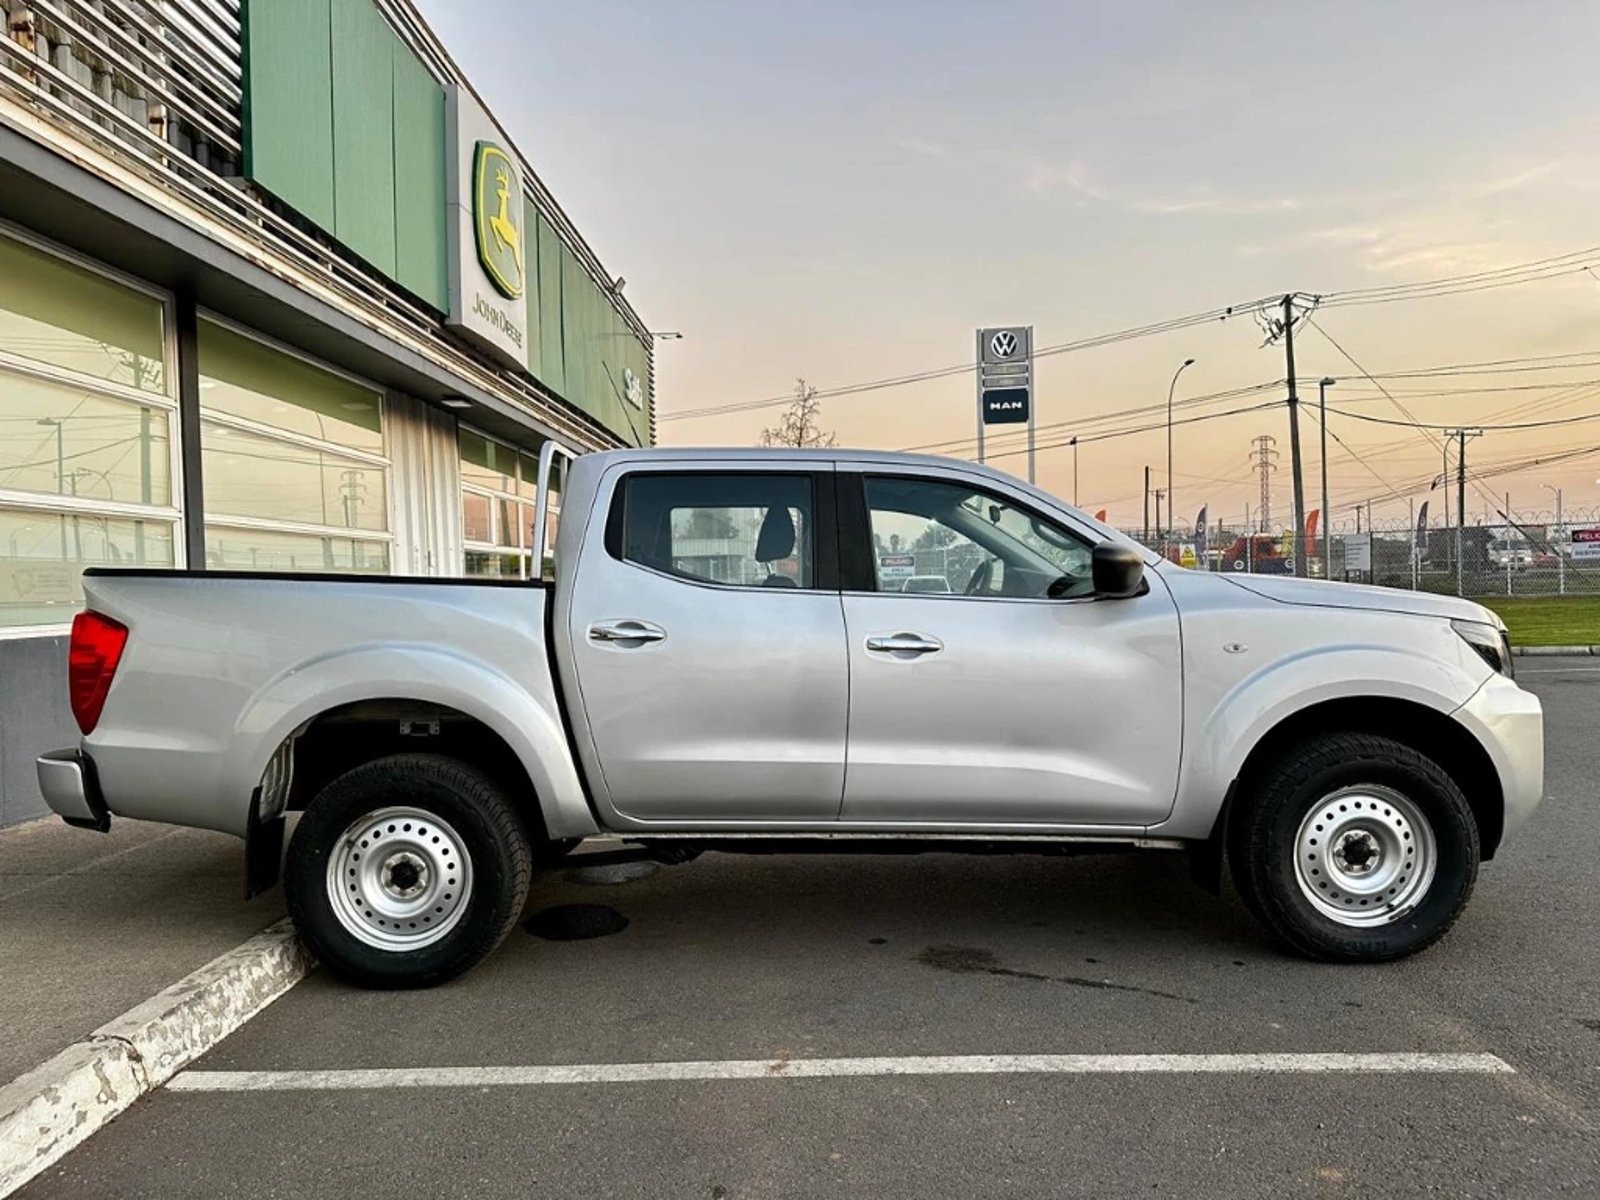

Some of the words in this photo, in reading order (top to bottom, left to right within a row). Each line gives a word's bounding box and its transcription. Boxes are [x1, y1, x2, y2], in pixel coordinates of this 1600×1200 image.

[472, 292, 499, 329] JOHN
[500, 310, 522, 349] DEERE
[990, 401, 1022, 410] MAN
